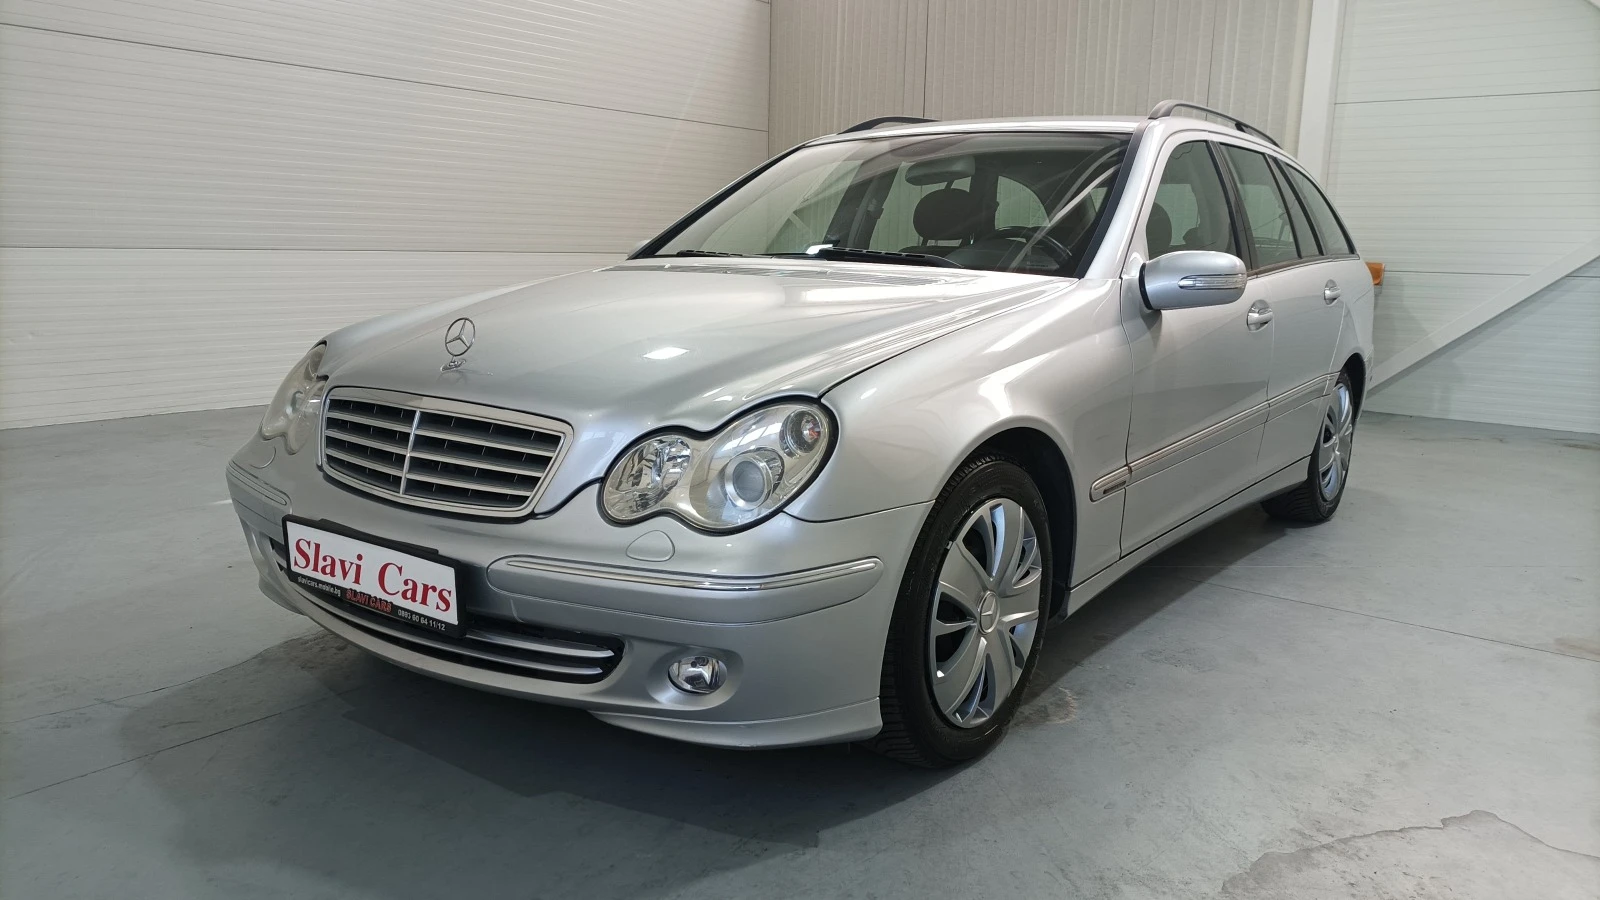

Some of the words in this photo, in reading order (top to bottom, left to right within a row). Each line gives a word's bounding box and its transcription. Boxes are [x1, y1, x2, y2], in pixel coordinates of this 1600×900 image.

[293, 538, 363, 586] Slavi
[378, 562, 452, 612] Cars
[297, 576, 341, 597] slavicars.mobile.bg
[346, 588, 369, 605] SLAVI
[369, 597, 392, 613] CARS
[420, 617, 428, 625] 64
[429, 620, 446, 631] 11/12
